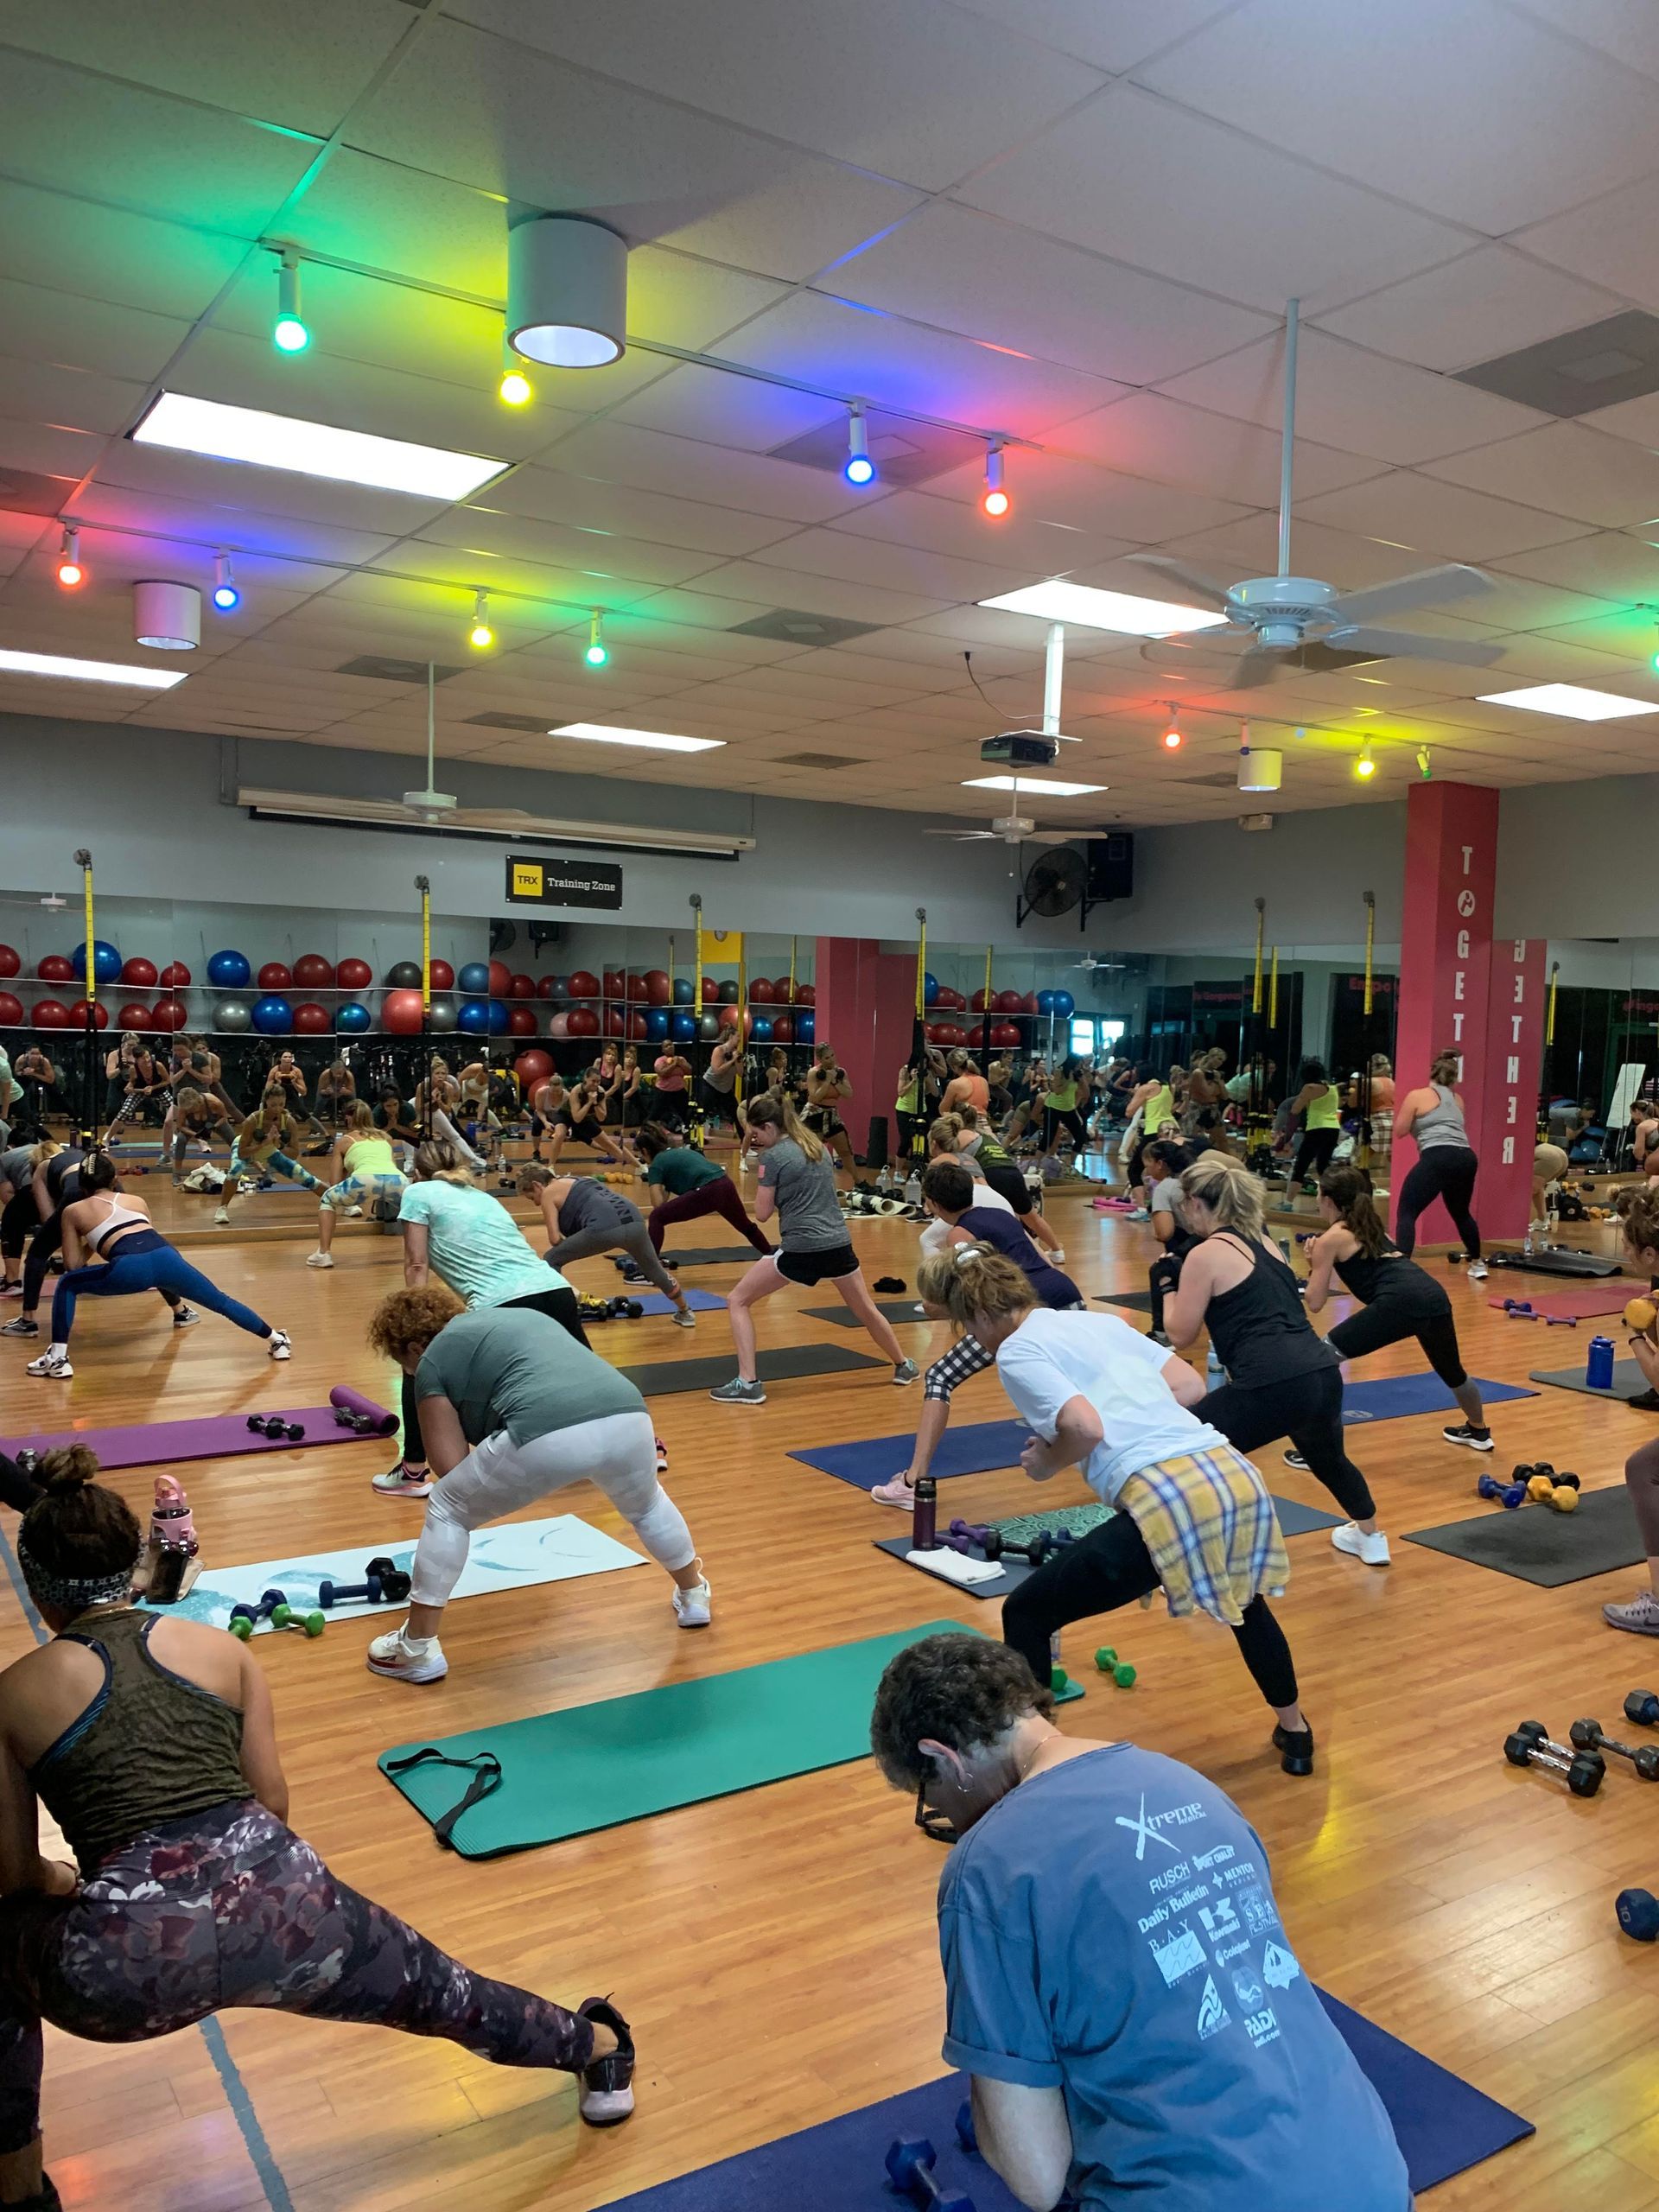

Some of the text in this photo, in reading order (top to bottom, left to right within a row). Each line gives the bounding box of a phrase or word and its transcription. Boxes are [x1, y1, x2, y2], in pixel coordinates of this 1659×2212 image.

[517, 875, 538, 886] TRX
[547, 877, 616, 892] Training Zone
[1115, 1792, 1203, 1861] Xtreme
[1148, 1861, 1191, 1895] RUSCH
[1137, 1905, 1170, 1935] Daily
[1168, 1885, 1210, 1914] Bulletin
[1244, 2007, 1277, 2038] PADI
